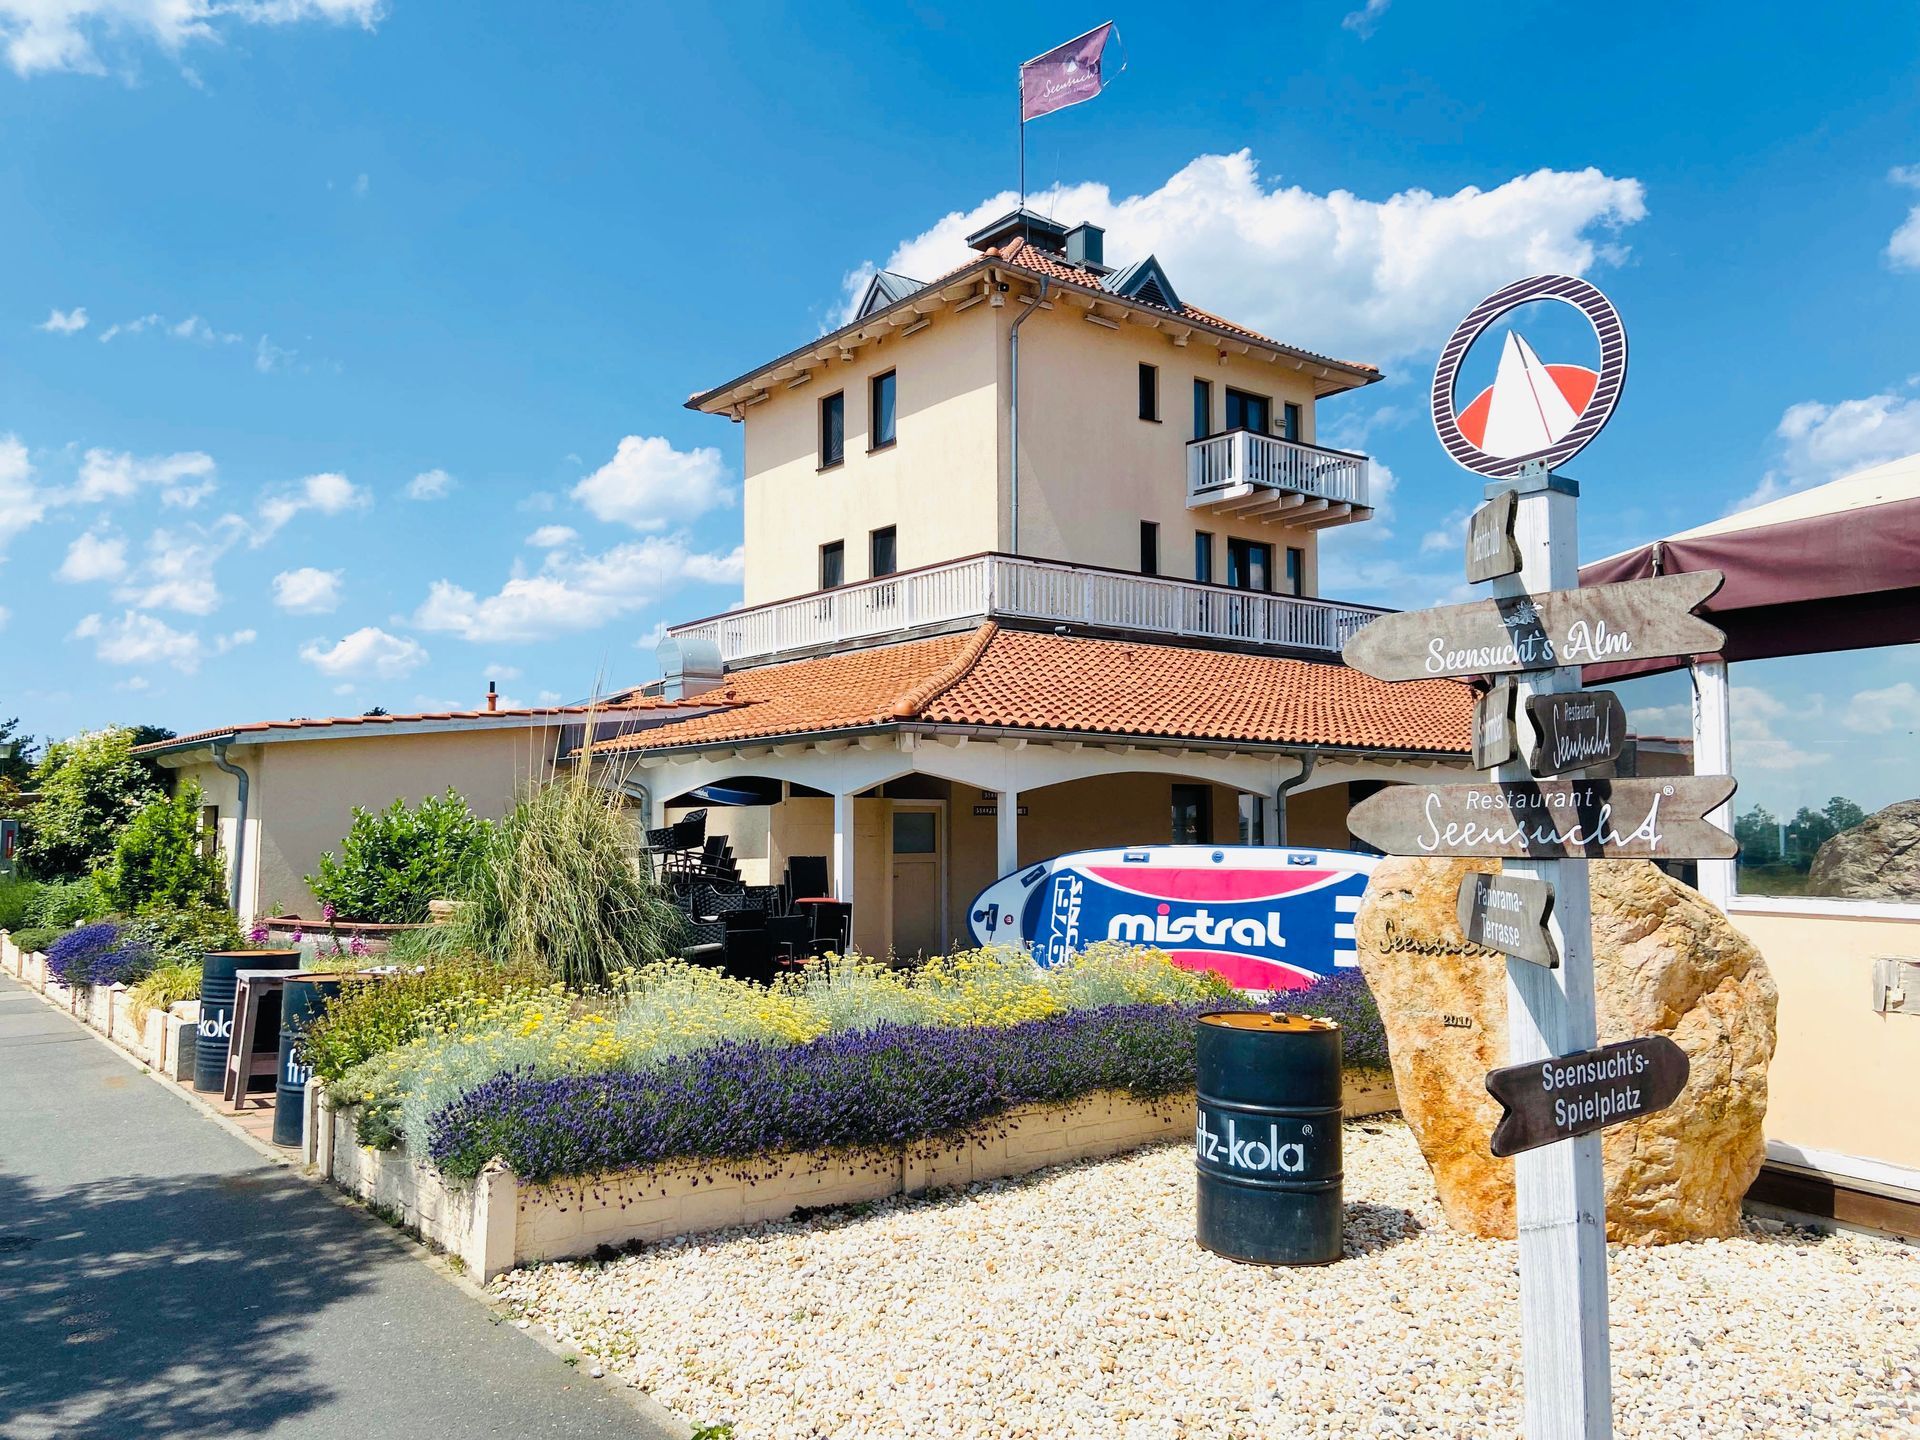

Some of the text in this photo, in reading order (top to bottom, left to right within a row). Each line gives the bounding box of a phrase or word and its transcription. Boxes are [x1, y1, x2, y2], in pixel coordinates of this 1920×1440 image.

[1563, 620, 1633, 662] Alm
[1564, 700, 1596, 721] Restaurant
[1553, 700, 1612, 769] Seensucht
[1466, 787, 1594, 810] Restaurant
[1048, 876, 1076, 966] 1976
[1107, 903, 1287, 948] mistral
[1481, 912, 1520, 947] Terrasse
[1555, 1085, 1642, 1132] Spielplatz
